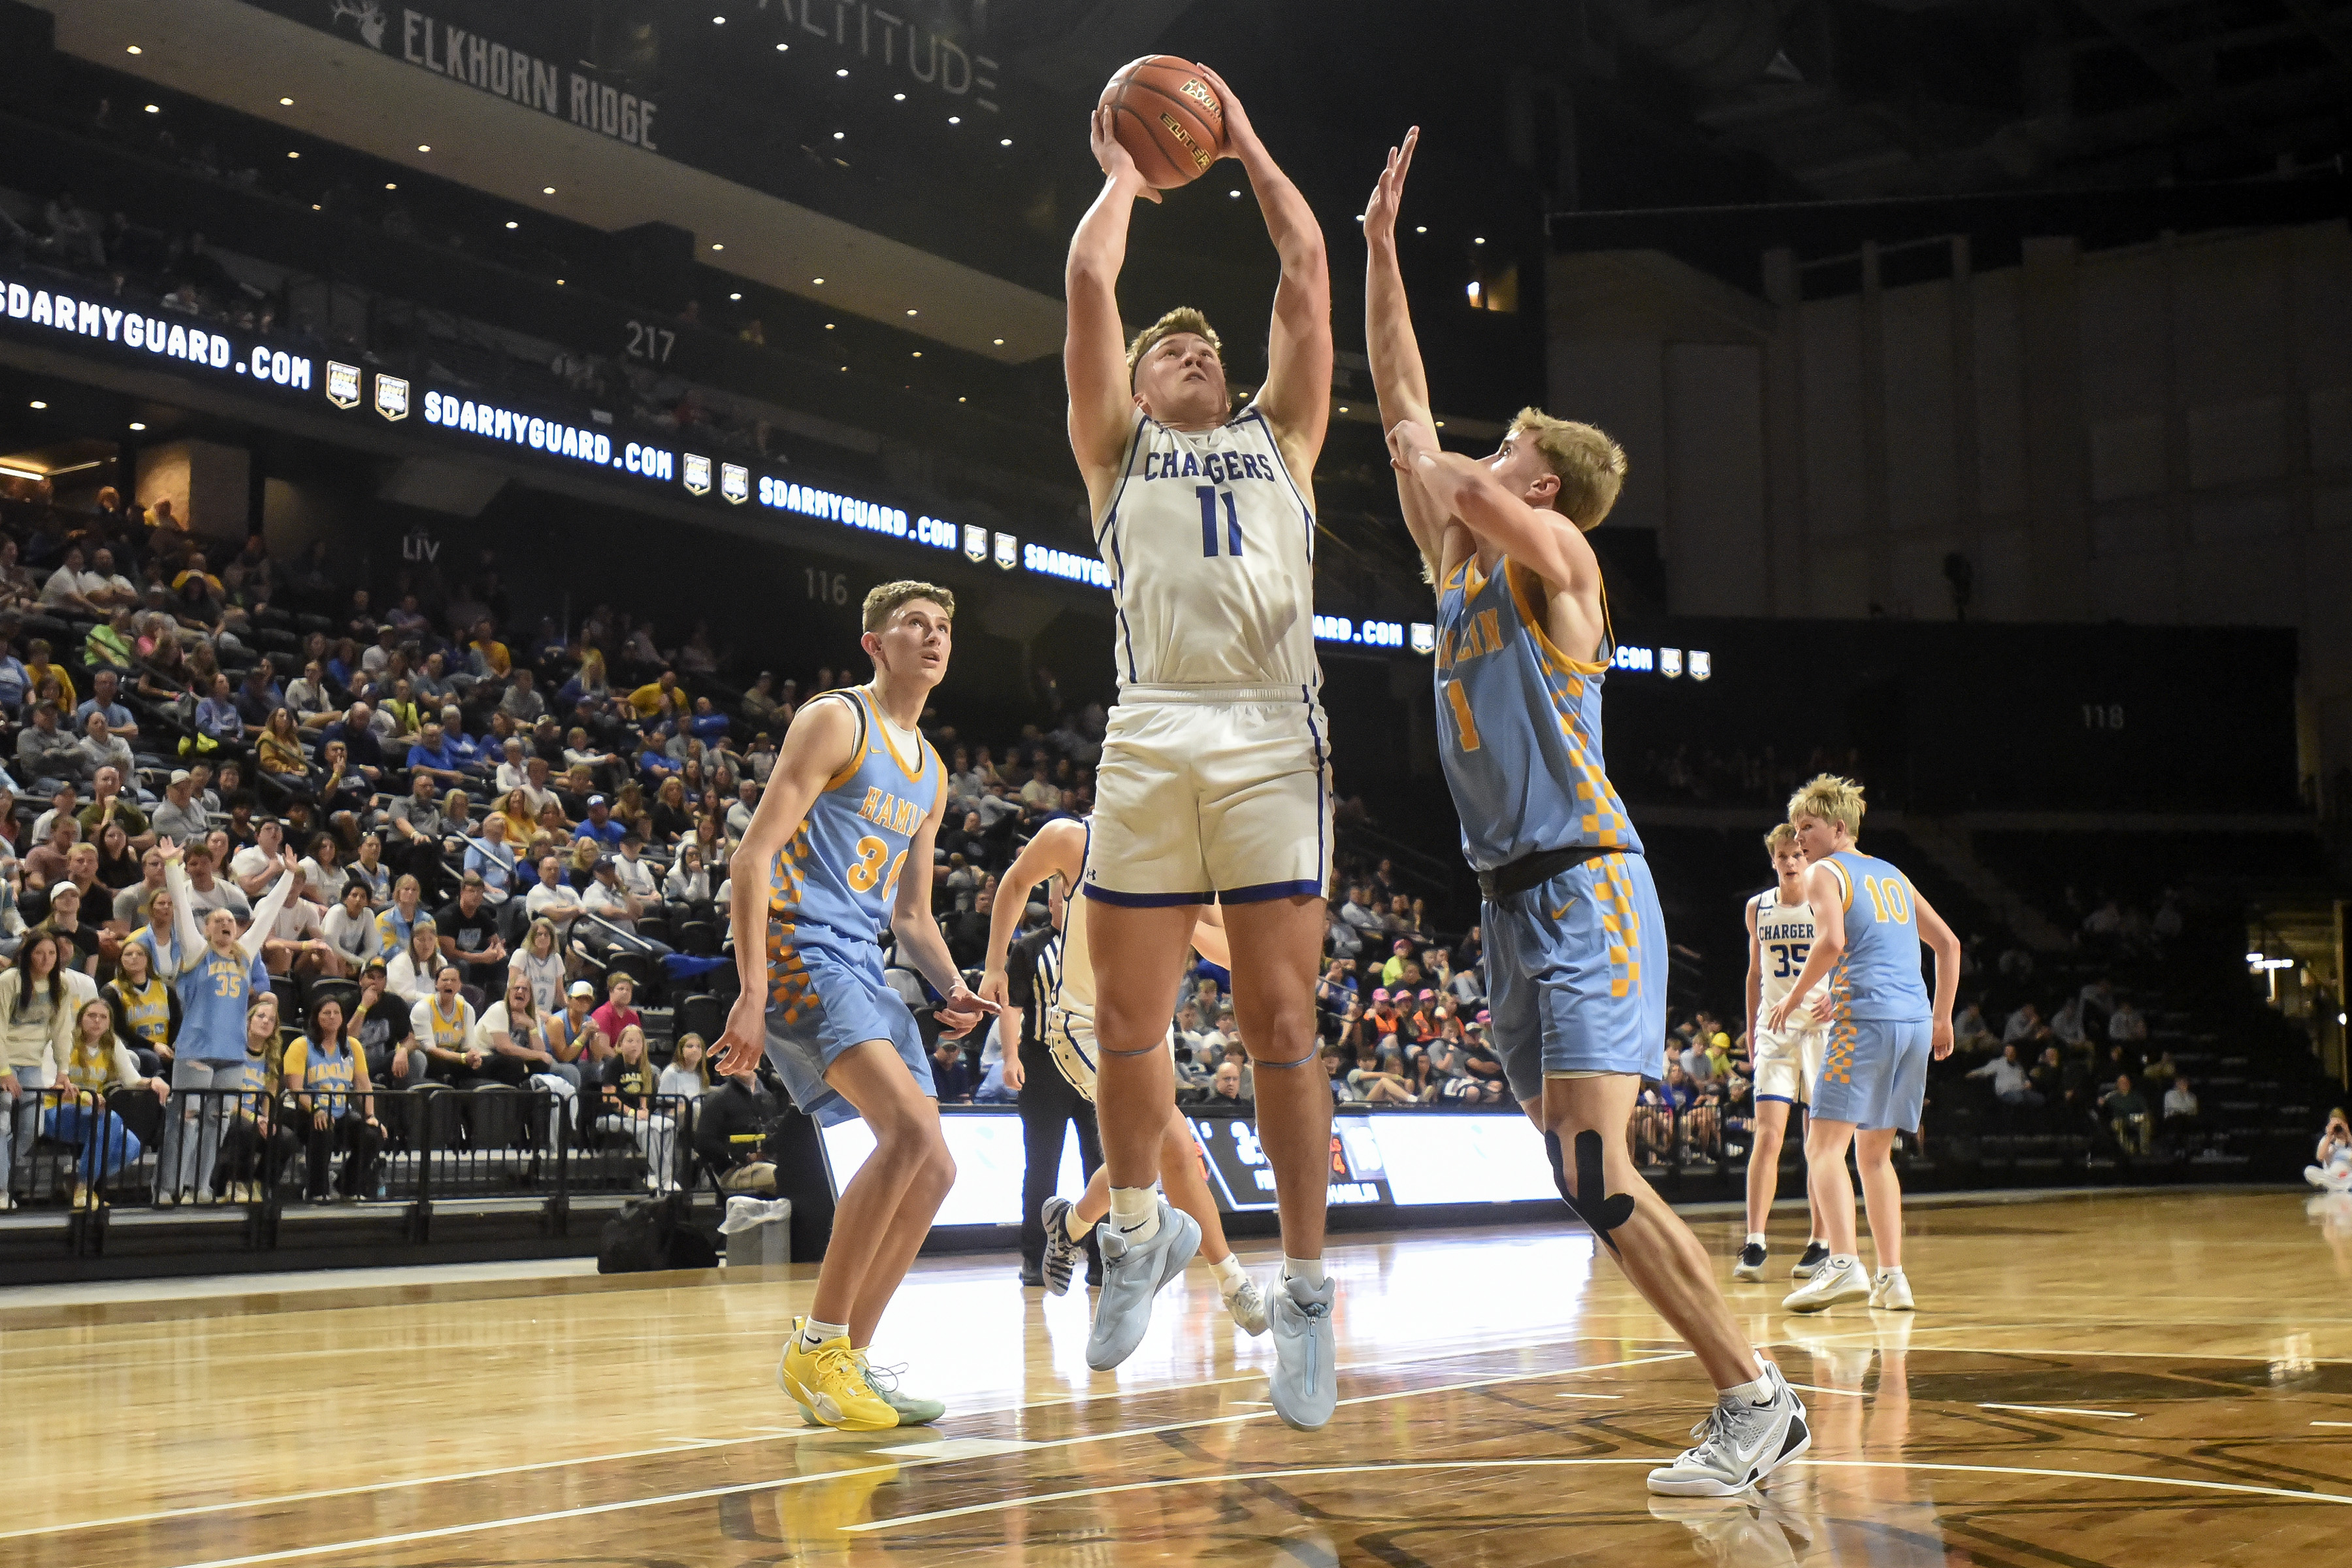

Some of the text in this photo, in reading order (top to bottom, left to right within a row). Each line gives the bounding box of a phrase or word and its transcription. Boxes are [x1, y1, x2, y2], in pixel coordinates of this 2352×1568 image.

[403, 8, 658, 152] ELKHORN RIDGE
[0, 280, 313, 390] DARMYGUARD.COM
[625, 320, 676, 363] 217
[424, 391, 674, 481] SDARMYGUARD.COM
[759, 476, 958, 549] SDARMYGUARD.COM
[1195, 485, 1244, 558] 11
[402, 535, 441, 562] LIV
[804, 566, 848, 606] 116
[1447, 678, 1480, 752] 1
[2082, 703, 2124, 730] 118
[1864, 874, 1910, 925] 10
[1759, 923, 1815, 941] CHARGER
[1769, 943, 1811, 978] 35
